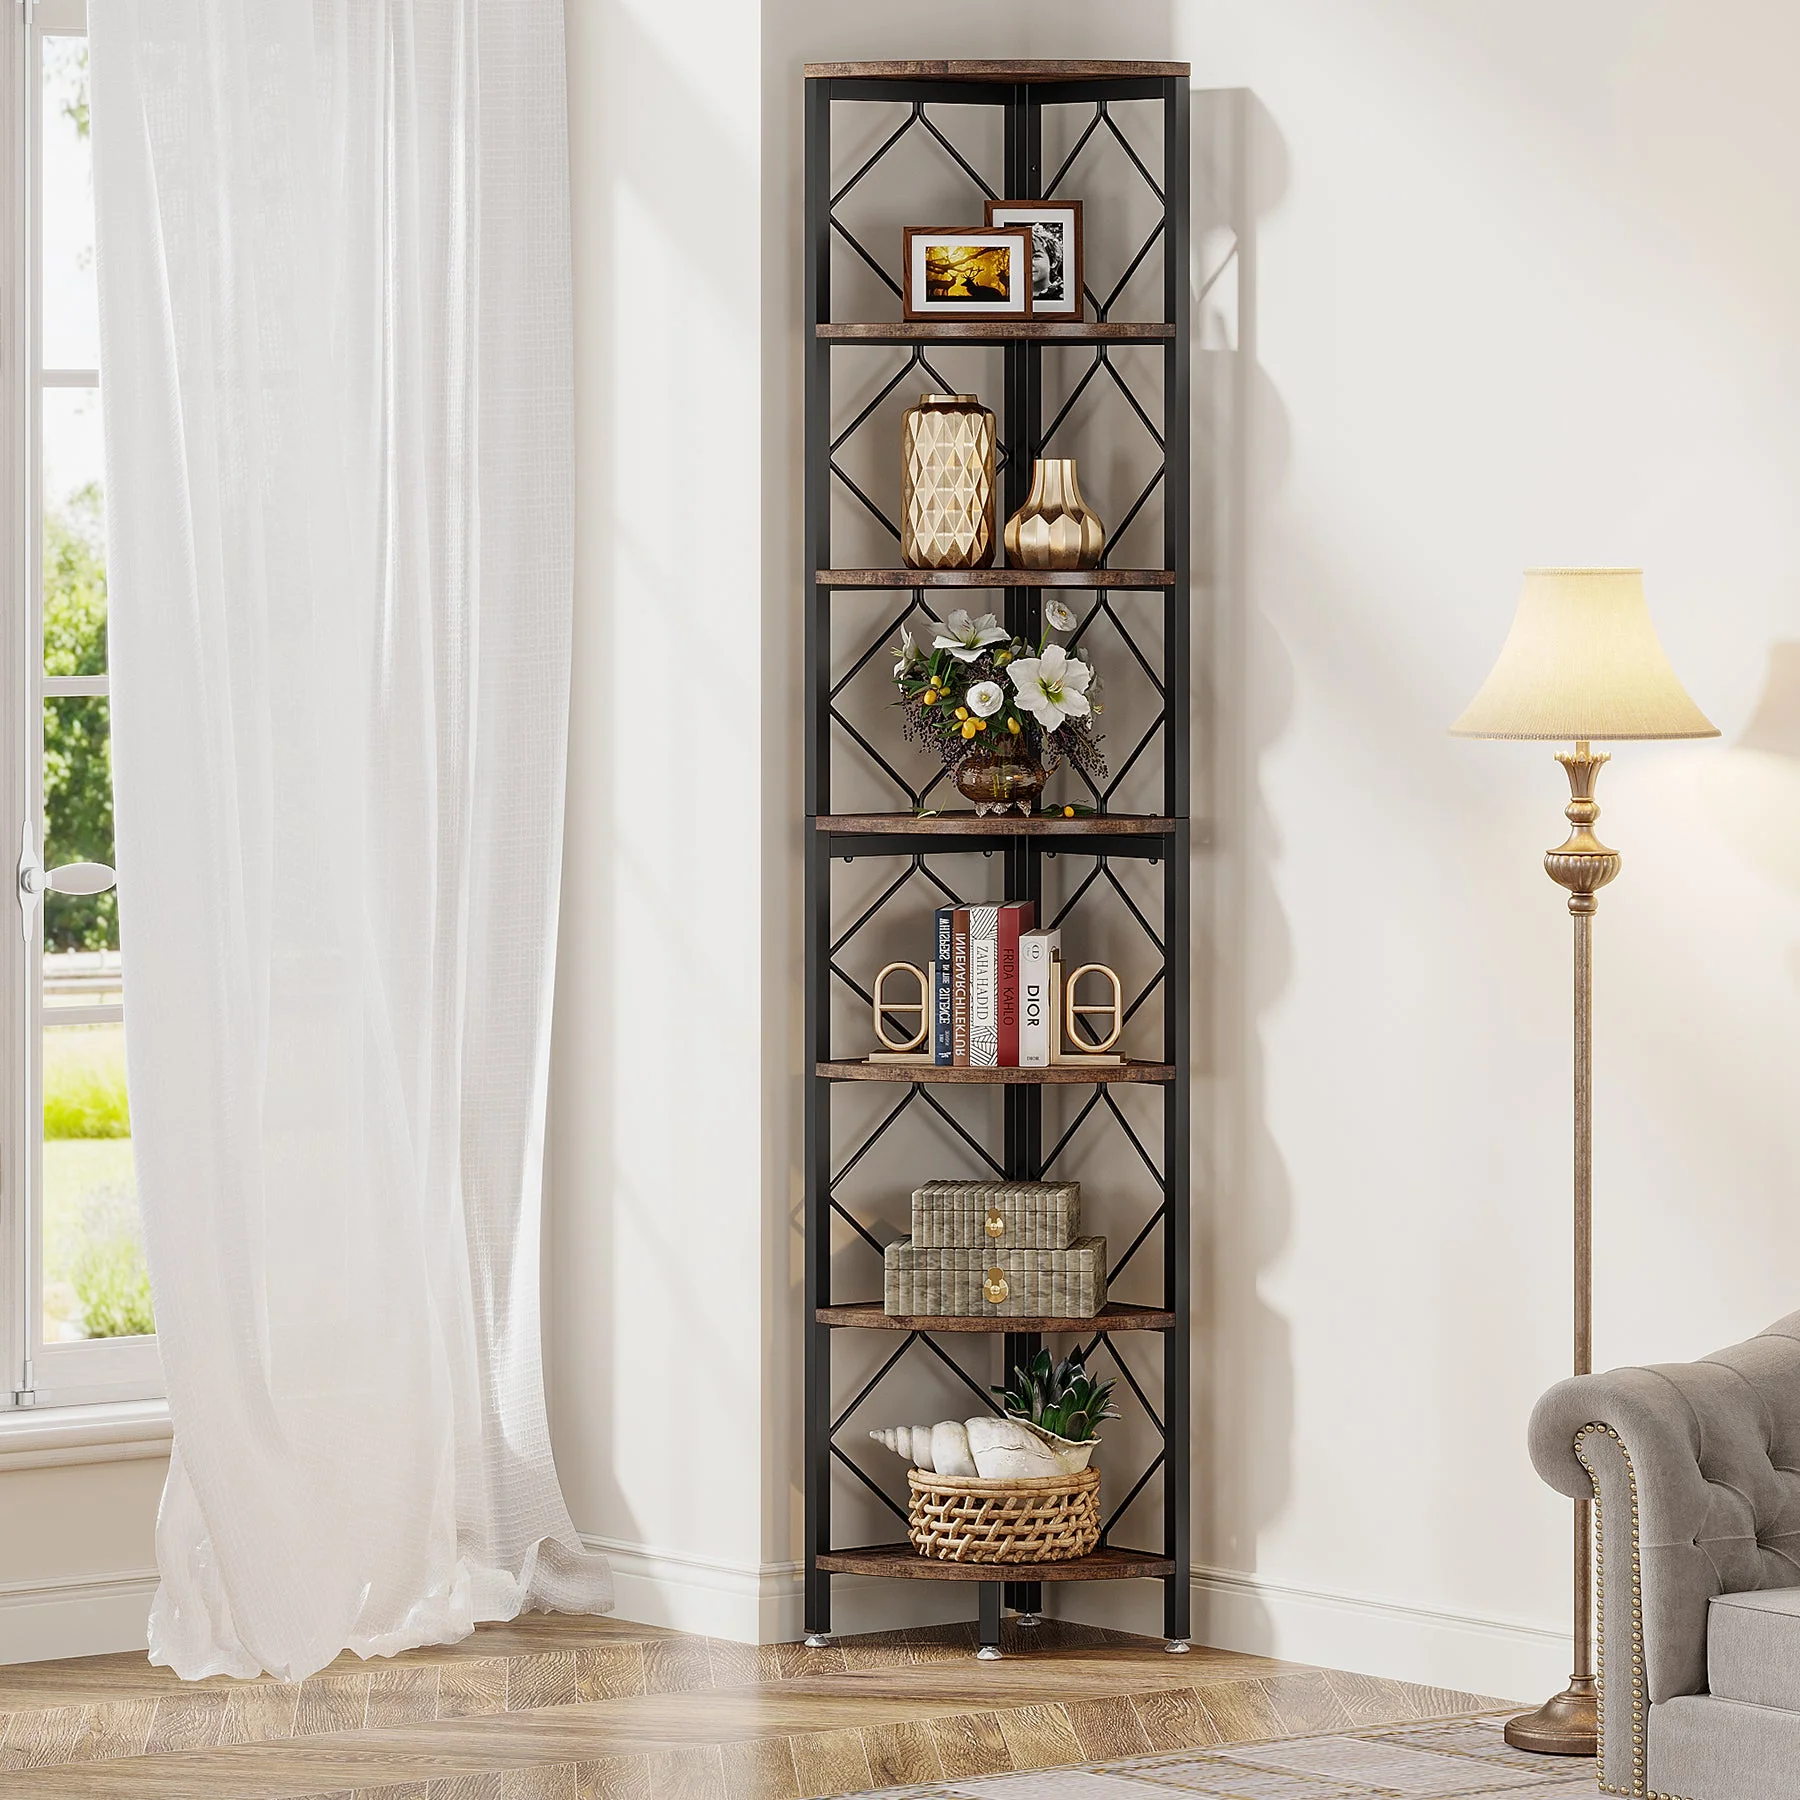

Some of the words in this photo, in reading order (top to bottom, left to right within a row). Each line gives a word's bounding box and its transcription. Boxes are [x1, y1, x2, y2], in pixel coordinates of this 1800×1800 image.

[976, 946, 988, 977] ZAHA
[1003, 948, 1014, 980] FRIDA
[976, 978, 988, 1020] HADID
[1003, 987, 1014, 1026] KAHLO
[1027, 985, 1040, 1027] DIOR
